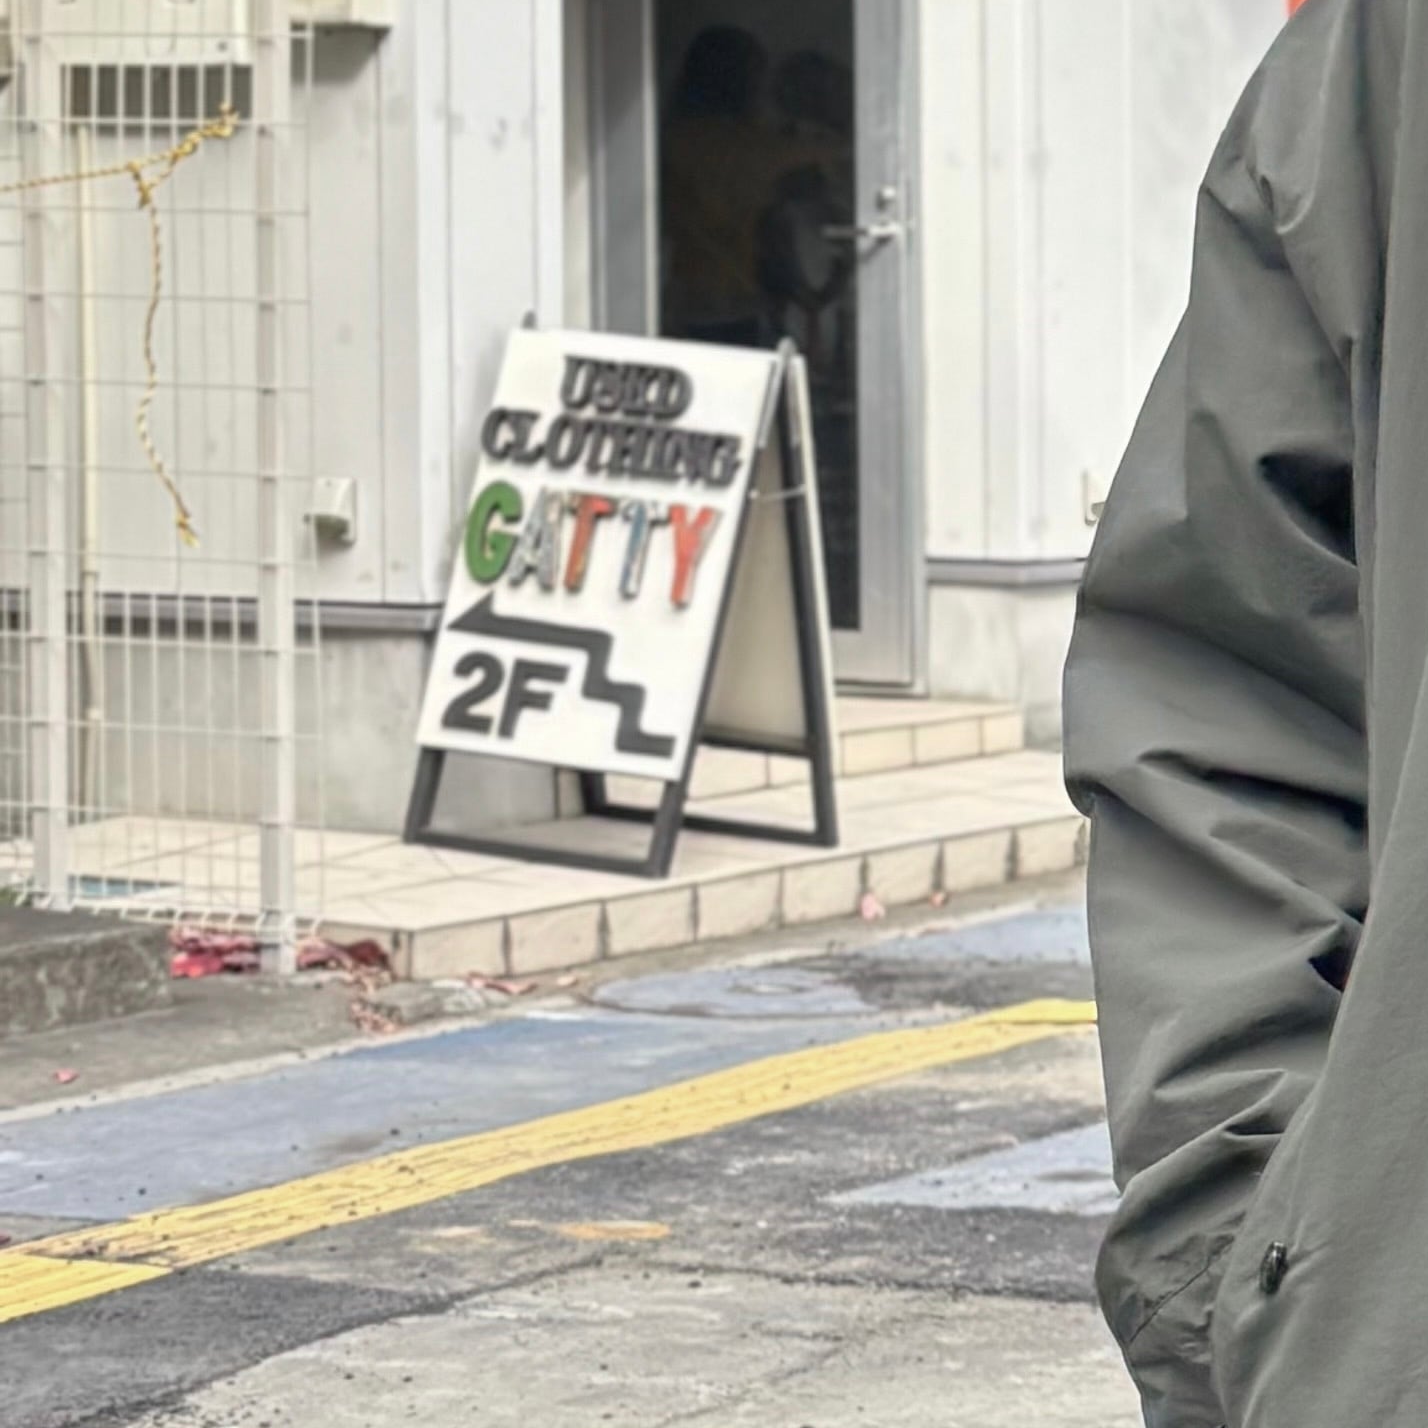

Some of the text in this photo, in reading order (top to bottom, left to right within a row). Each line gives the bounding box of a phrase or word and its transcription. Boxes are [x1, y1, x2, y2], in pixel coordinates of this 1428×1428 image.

[561, 355, 694, 420] USED
[481, 407, 743, 487] CLOTHING
[464, 480, 723, 608] GATTY
[441, 651, 570, 739] 2F
